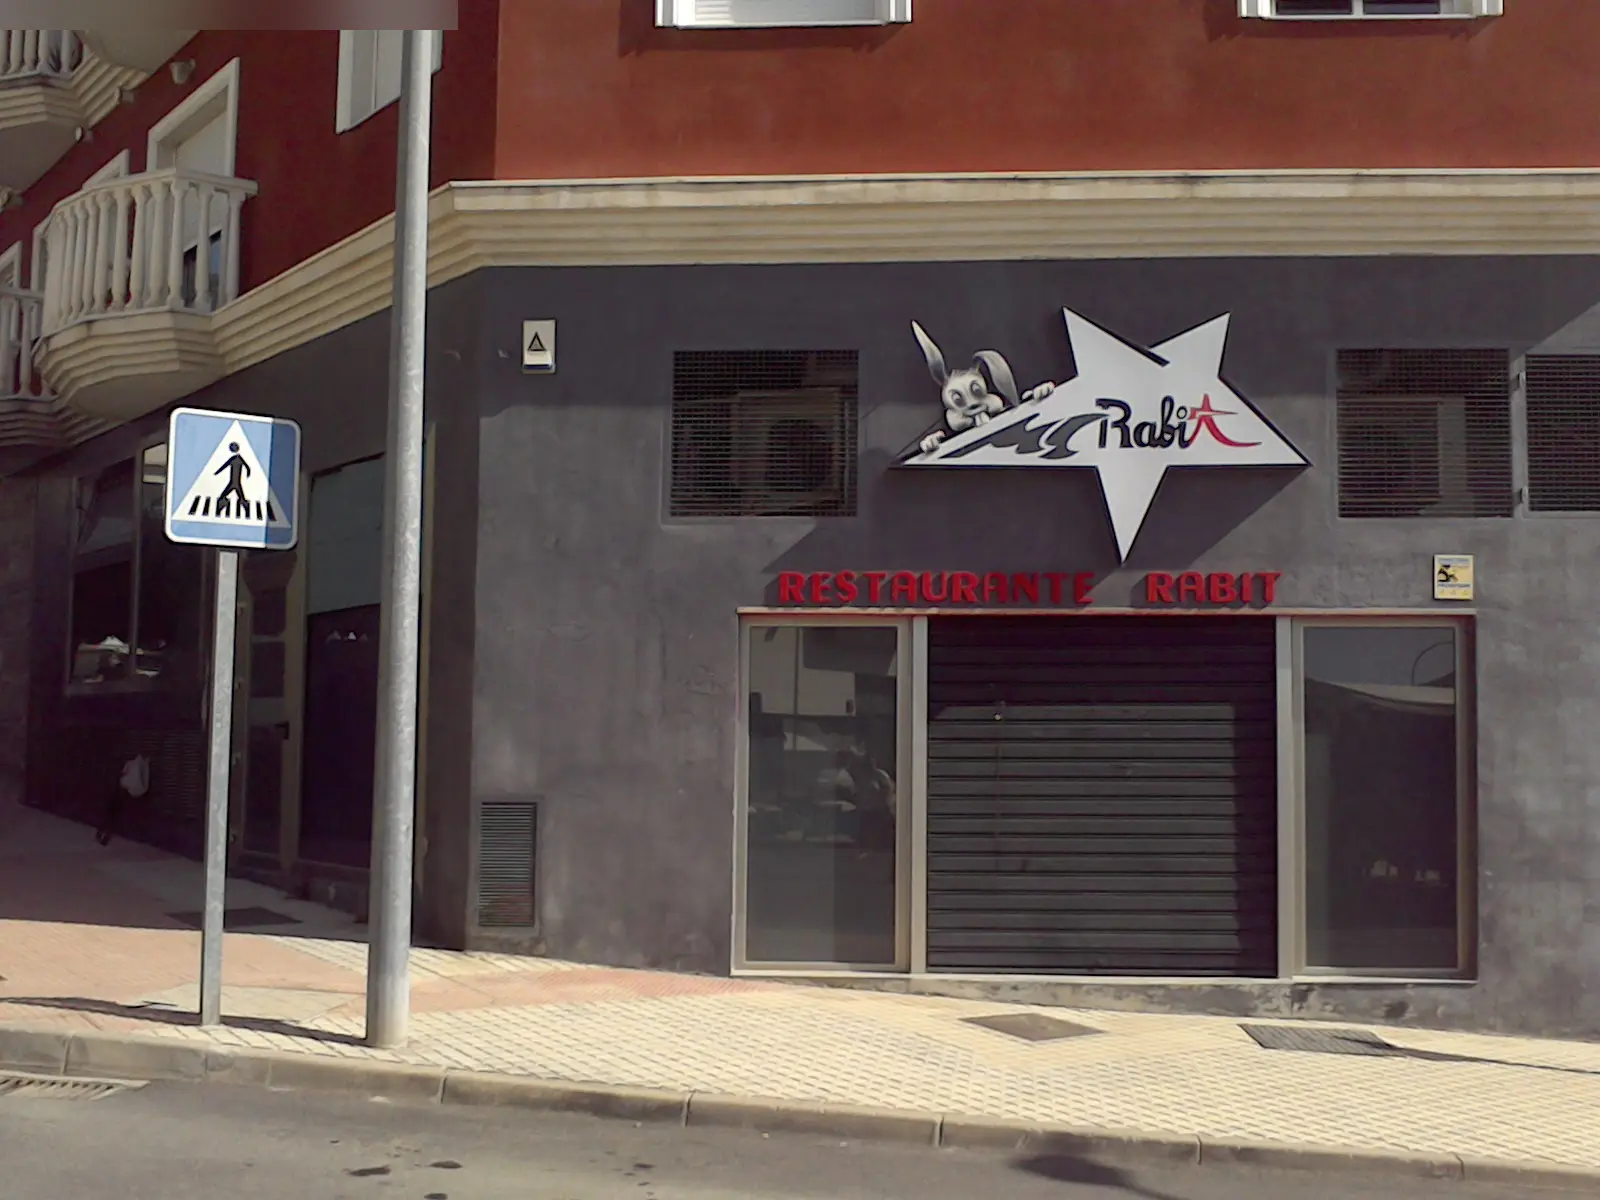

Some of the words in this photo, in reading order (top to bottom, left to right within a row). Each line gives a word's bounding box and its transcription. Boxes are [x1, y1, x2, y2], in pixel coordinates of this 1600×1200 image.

[1095, 393, 1262, 449] Rabit
[778, 570, 1093, 603] RESTAURANTE
[1146, 571, 1281, 603] RABIT
